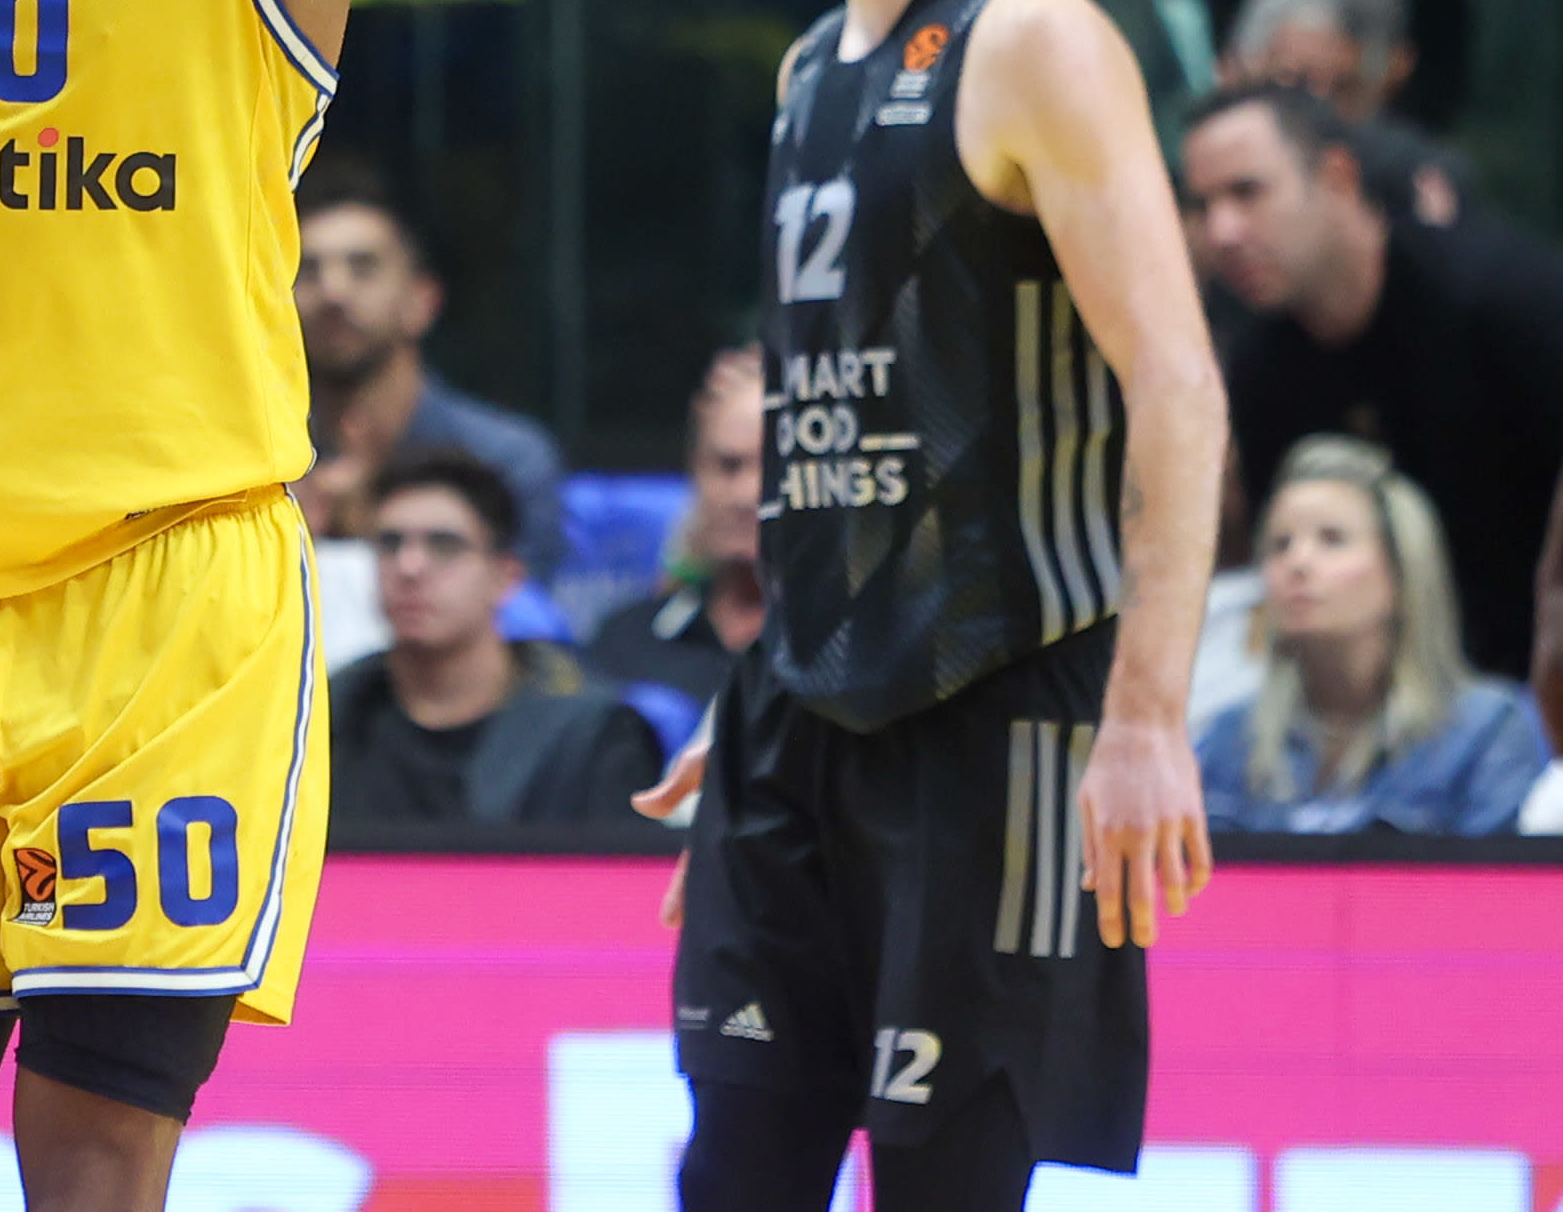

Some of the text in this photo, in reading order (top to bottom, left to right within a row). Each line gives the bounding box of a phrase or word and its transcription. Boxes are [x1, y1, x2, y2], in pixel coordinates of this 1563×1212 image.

[774, 176, 858, 305] 12
[780, 346, 897, 402] MART
[775, 405, 859, 457] OOD
[779, 457, 910, 511] HINGS
[57, 795, 240, 931] 50
[870, 1028, 941, 1105] 12
